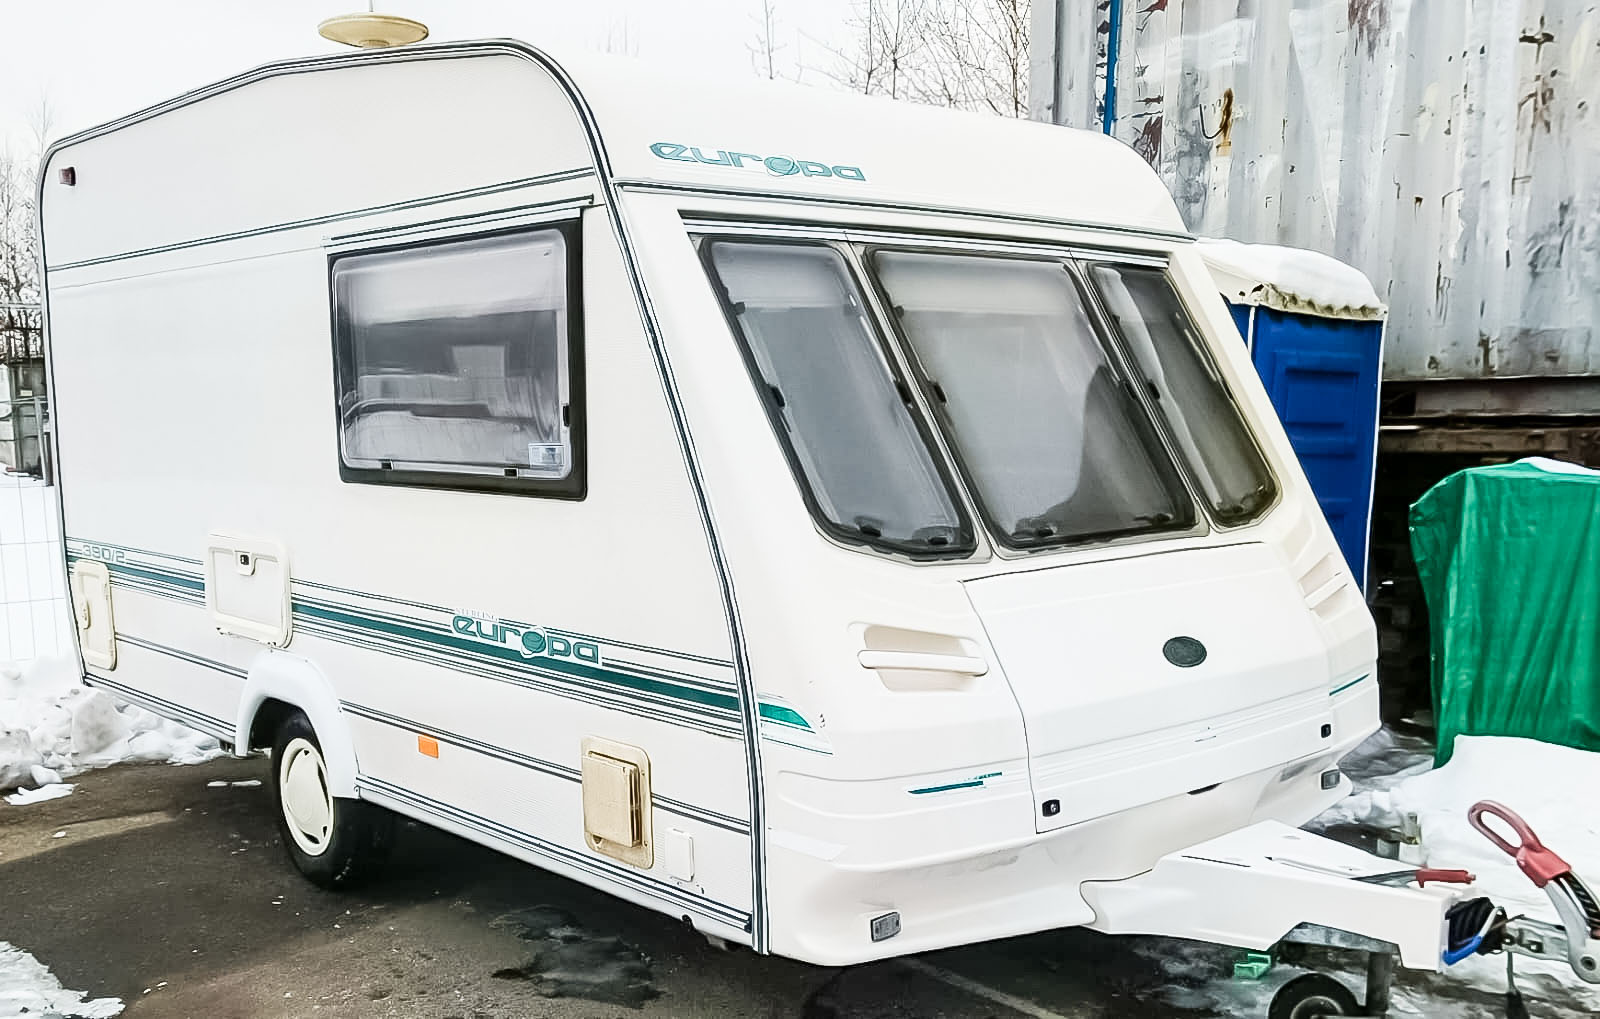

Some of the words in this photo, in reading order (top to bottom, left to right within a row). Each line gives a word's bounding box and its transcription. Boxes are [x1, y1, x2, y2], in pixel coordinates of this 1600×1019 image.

[649, 142, 866, 182] europa
[82, 545, 125, 563] 390/2
[452, 615, 599, 664] europa
